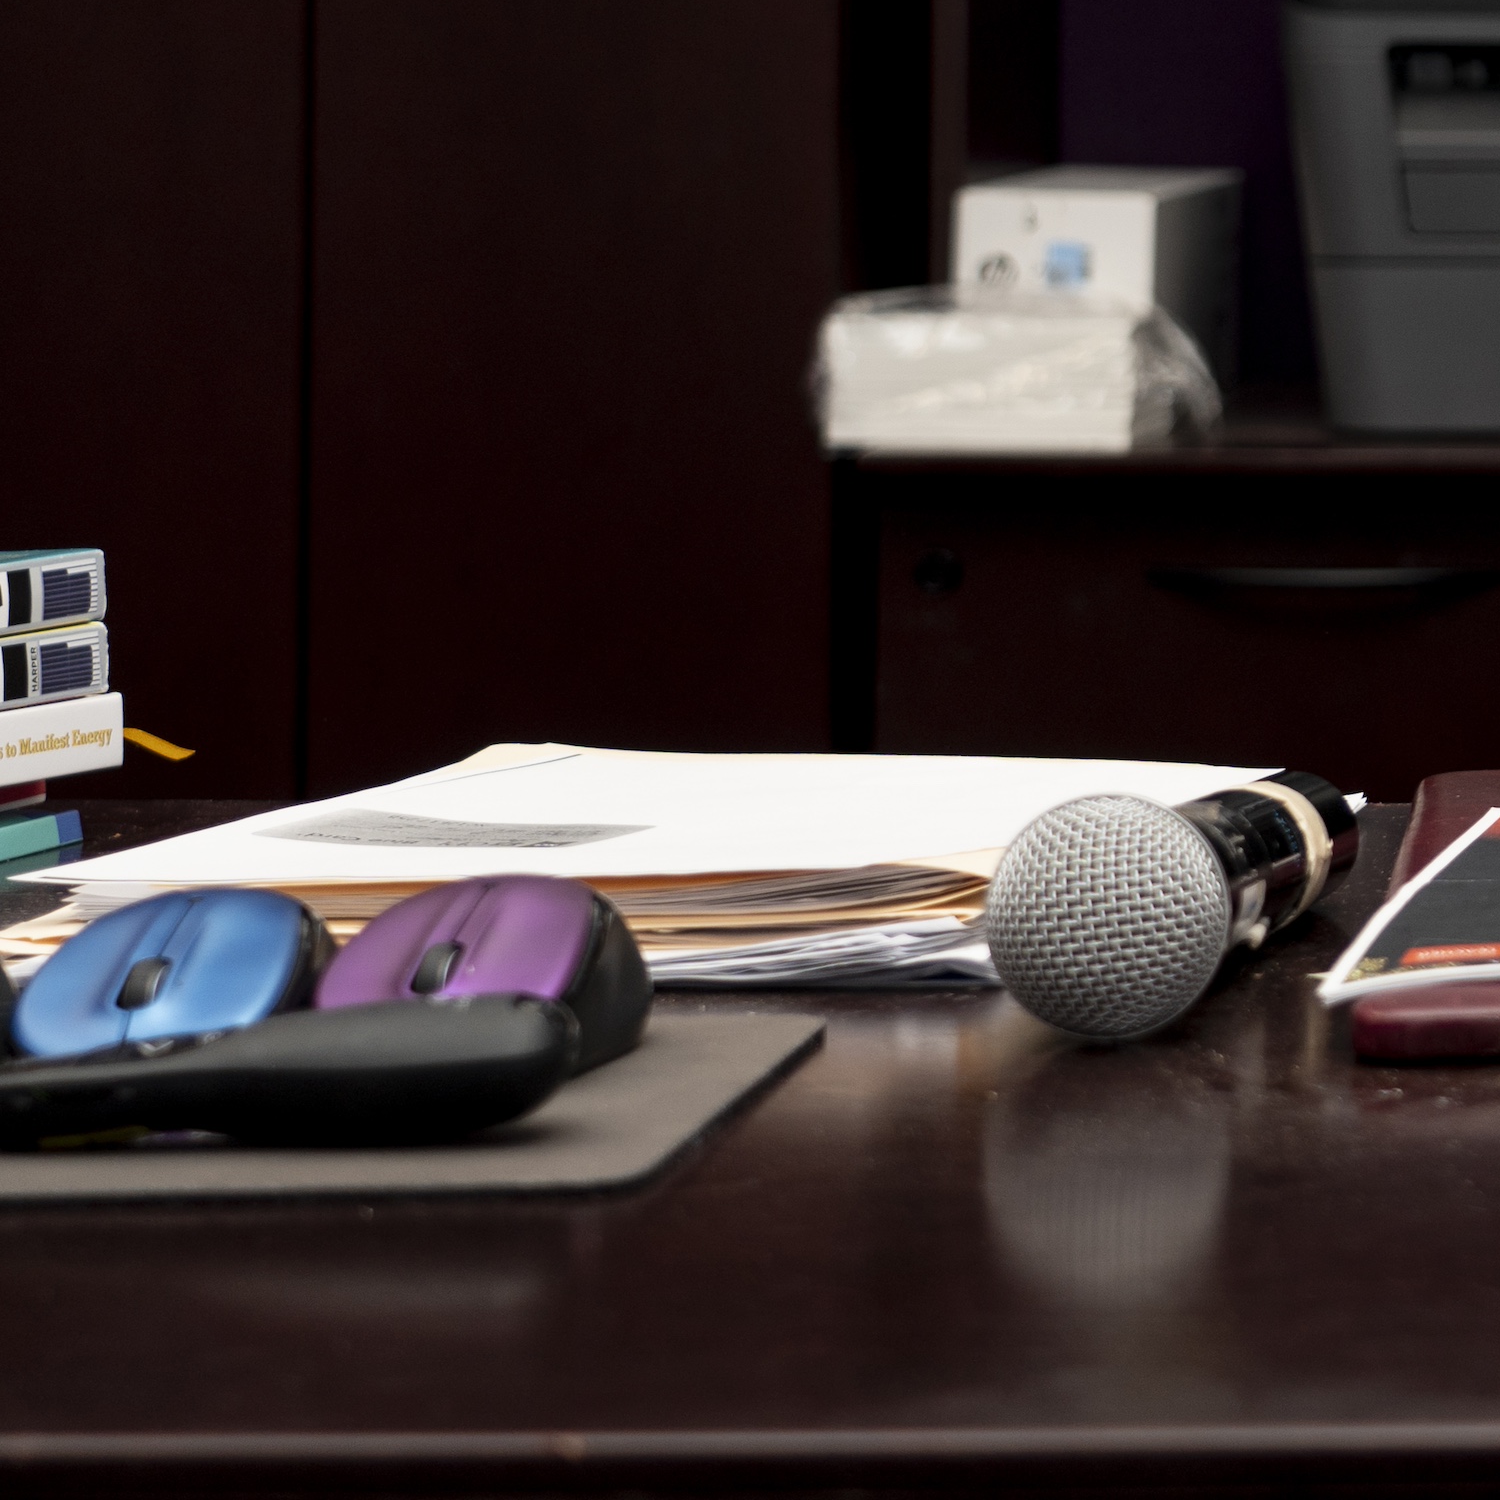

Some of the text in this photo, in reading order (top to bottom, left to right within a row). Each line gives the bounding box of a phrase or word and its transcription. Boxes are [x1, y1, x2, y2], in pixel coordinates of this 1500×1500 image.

[6, 742, 17, 758] to
[19, 732, 70, 756] Manifest
[71, 729, 113, 747] Energy
